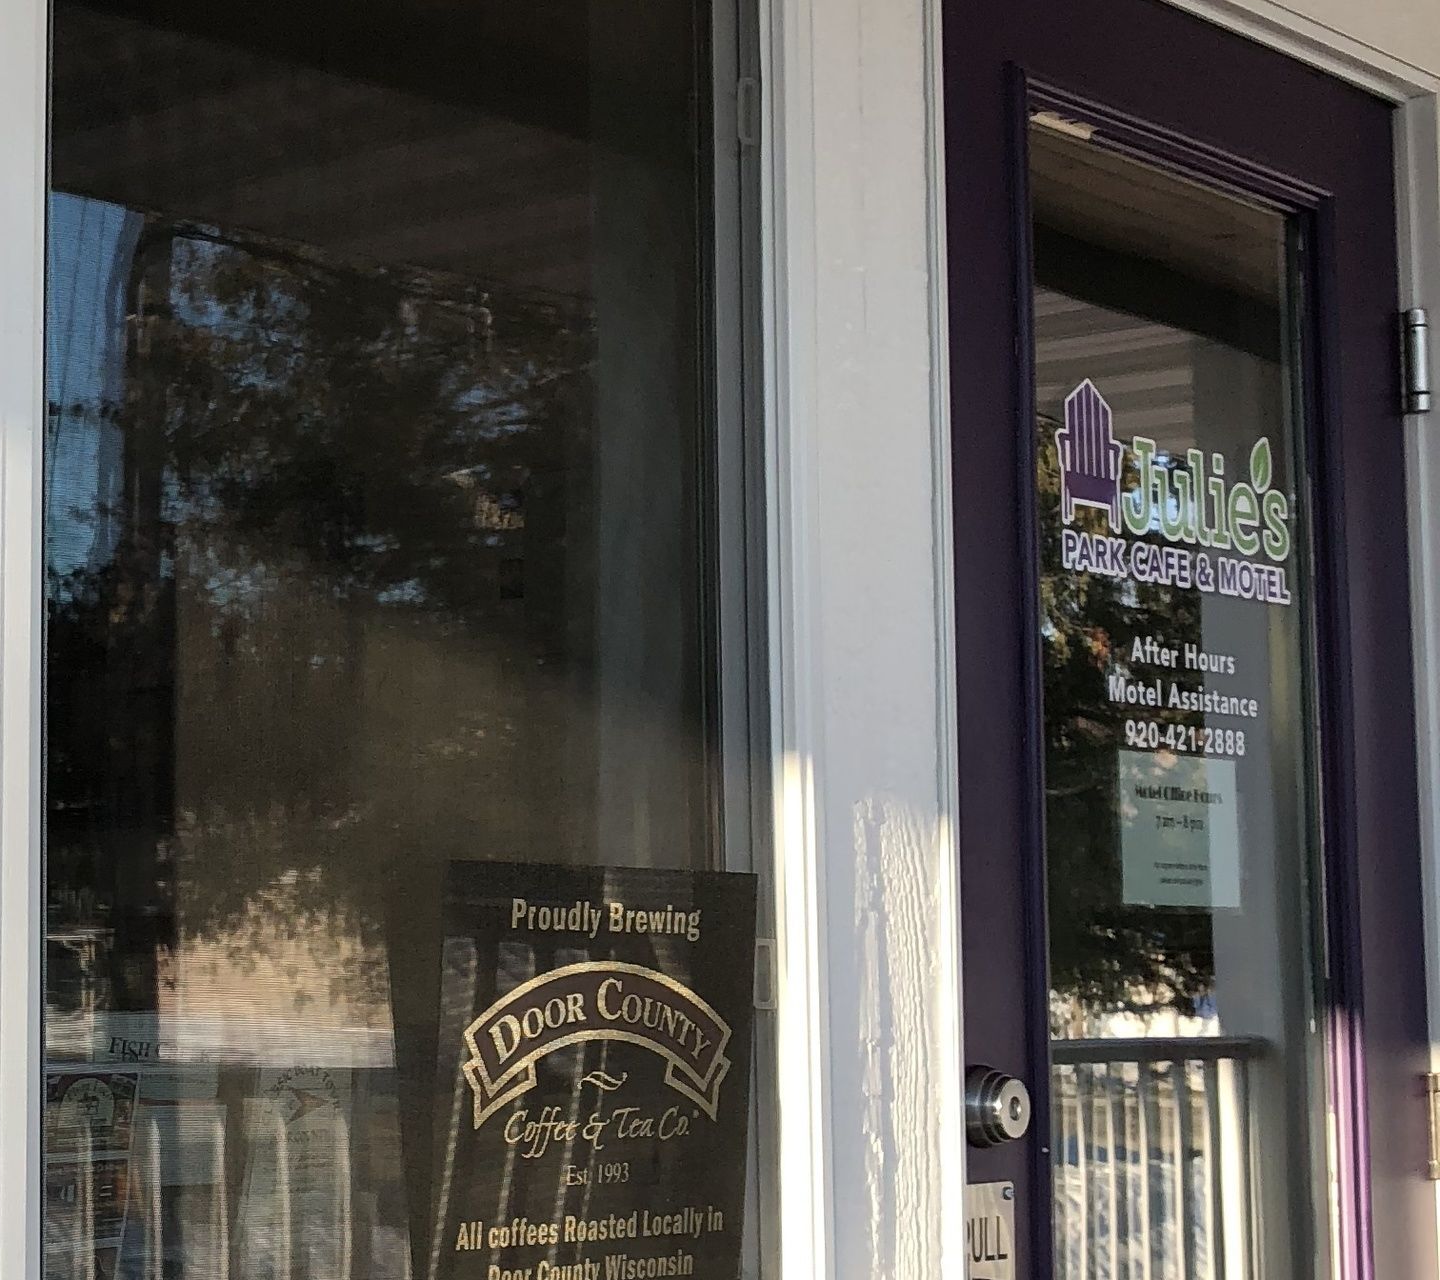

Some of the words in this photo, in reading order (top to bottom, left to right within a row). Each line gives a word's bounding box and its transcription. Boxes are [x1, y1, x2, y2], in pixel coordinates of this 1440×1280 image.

[1062, 529, 1128, 578] PARK
[1131, 541, 1192, 589] CAFE
[1196, 553, 1215, 592] &
[1218, 557, 1291, 605] MOTEL
[1130, 635, 1179, 669] After
[1184, 643, 1236, 675] Hours
[1108, 675, 1162, 707] Motel
[1167, 682, 1259, 718] Assistance
[1125, 719, 1246, 757] 920-421-2888
[511, 898, 601, 938] Proudly
[609, 902, 702, 942] Brewing
[488, 992, 587, 1065] DOOR
[596, 976, 712, 1060] COUNTY
[504, 1106, 580, 1159] Coffee
[582, 1111, 611, 1151] &
[612, 1107, 655, 1140] Tea
[597, 1162, 630, 1185] 1993
[456, 1220, 483, 1251] All
[488, 1216, 559, 1250] coffees
[564, 1209, 637, 1244] Roasted
[643, 1205, 703, 1238] Locally
[707, 1204, 724, 1232] in
[966, 1216, 1008, 1263] ULL
[605, 1249, 694, 1280] Wisconsin
